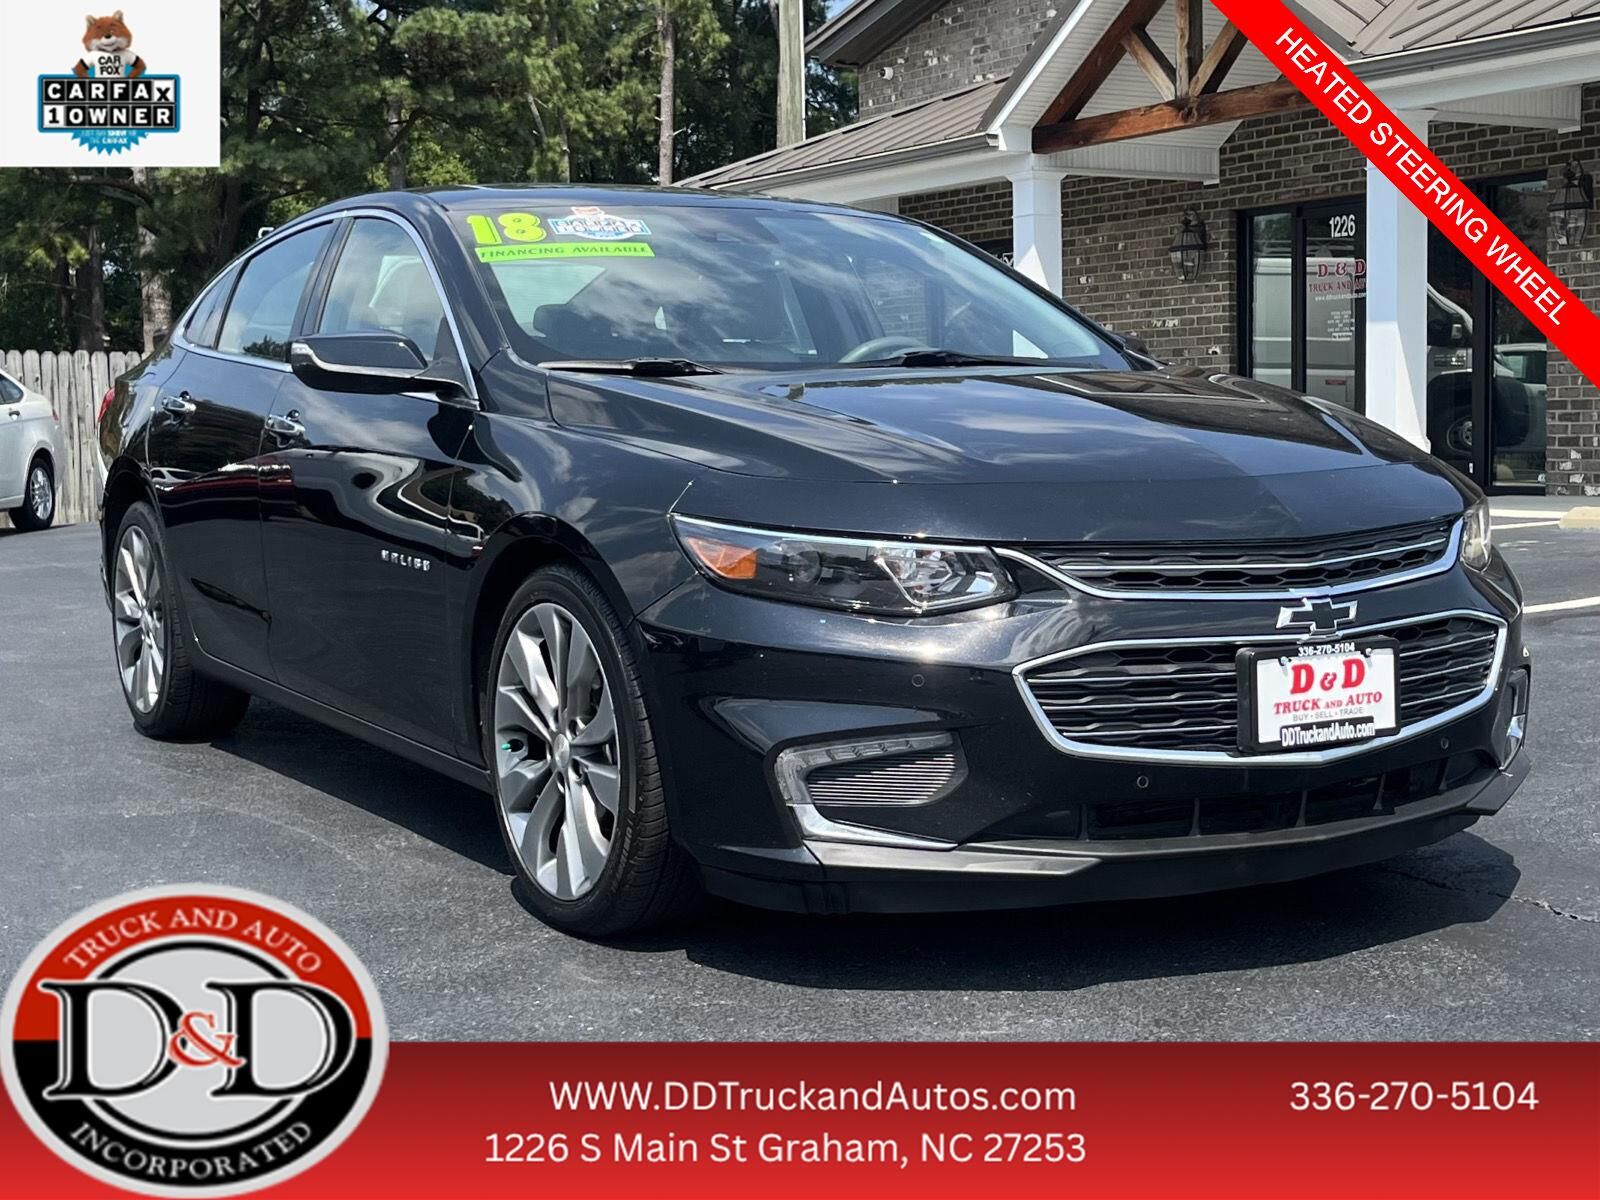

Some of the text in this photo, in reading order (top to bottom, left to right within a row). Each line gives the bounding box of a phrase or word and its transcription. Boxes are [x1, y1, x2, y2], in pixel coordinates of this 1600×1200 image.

[467, 212, 547, 245] 18
[1329, 214, 1356, 238] 1226
[481, 246, 648, 258] FINANCING AVAILABLE
[1317, 258, 1366, 278] D & D
[1308, 283, 1333, 293] TRUCK
[1298, 642, 1355, 656] 336-270-5104
[1290, 658, 1366, 694] D & D
[1273, 691, 1383, 715] TRUCK AND AUTO
[1293, 706, 1364, 722] BUY SELL TRADE
[1281, 721, 1376, 747] DDTruckandAuto.com
